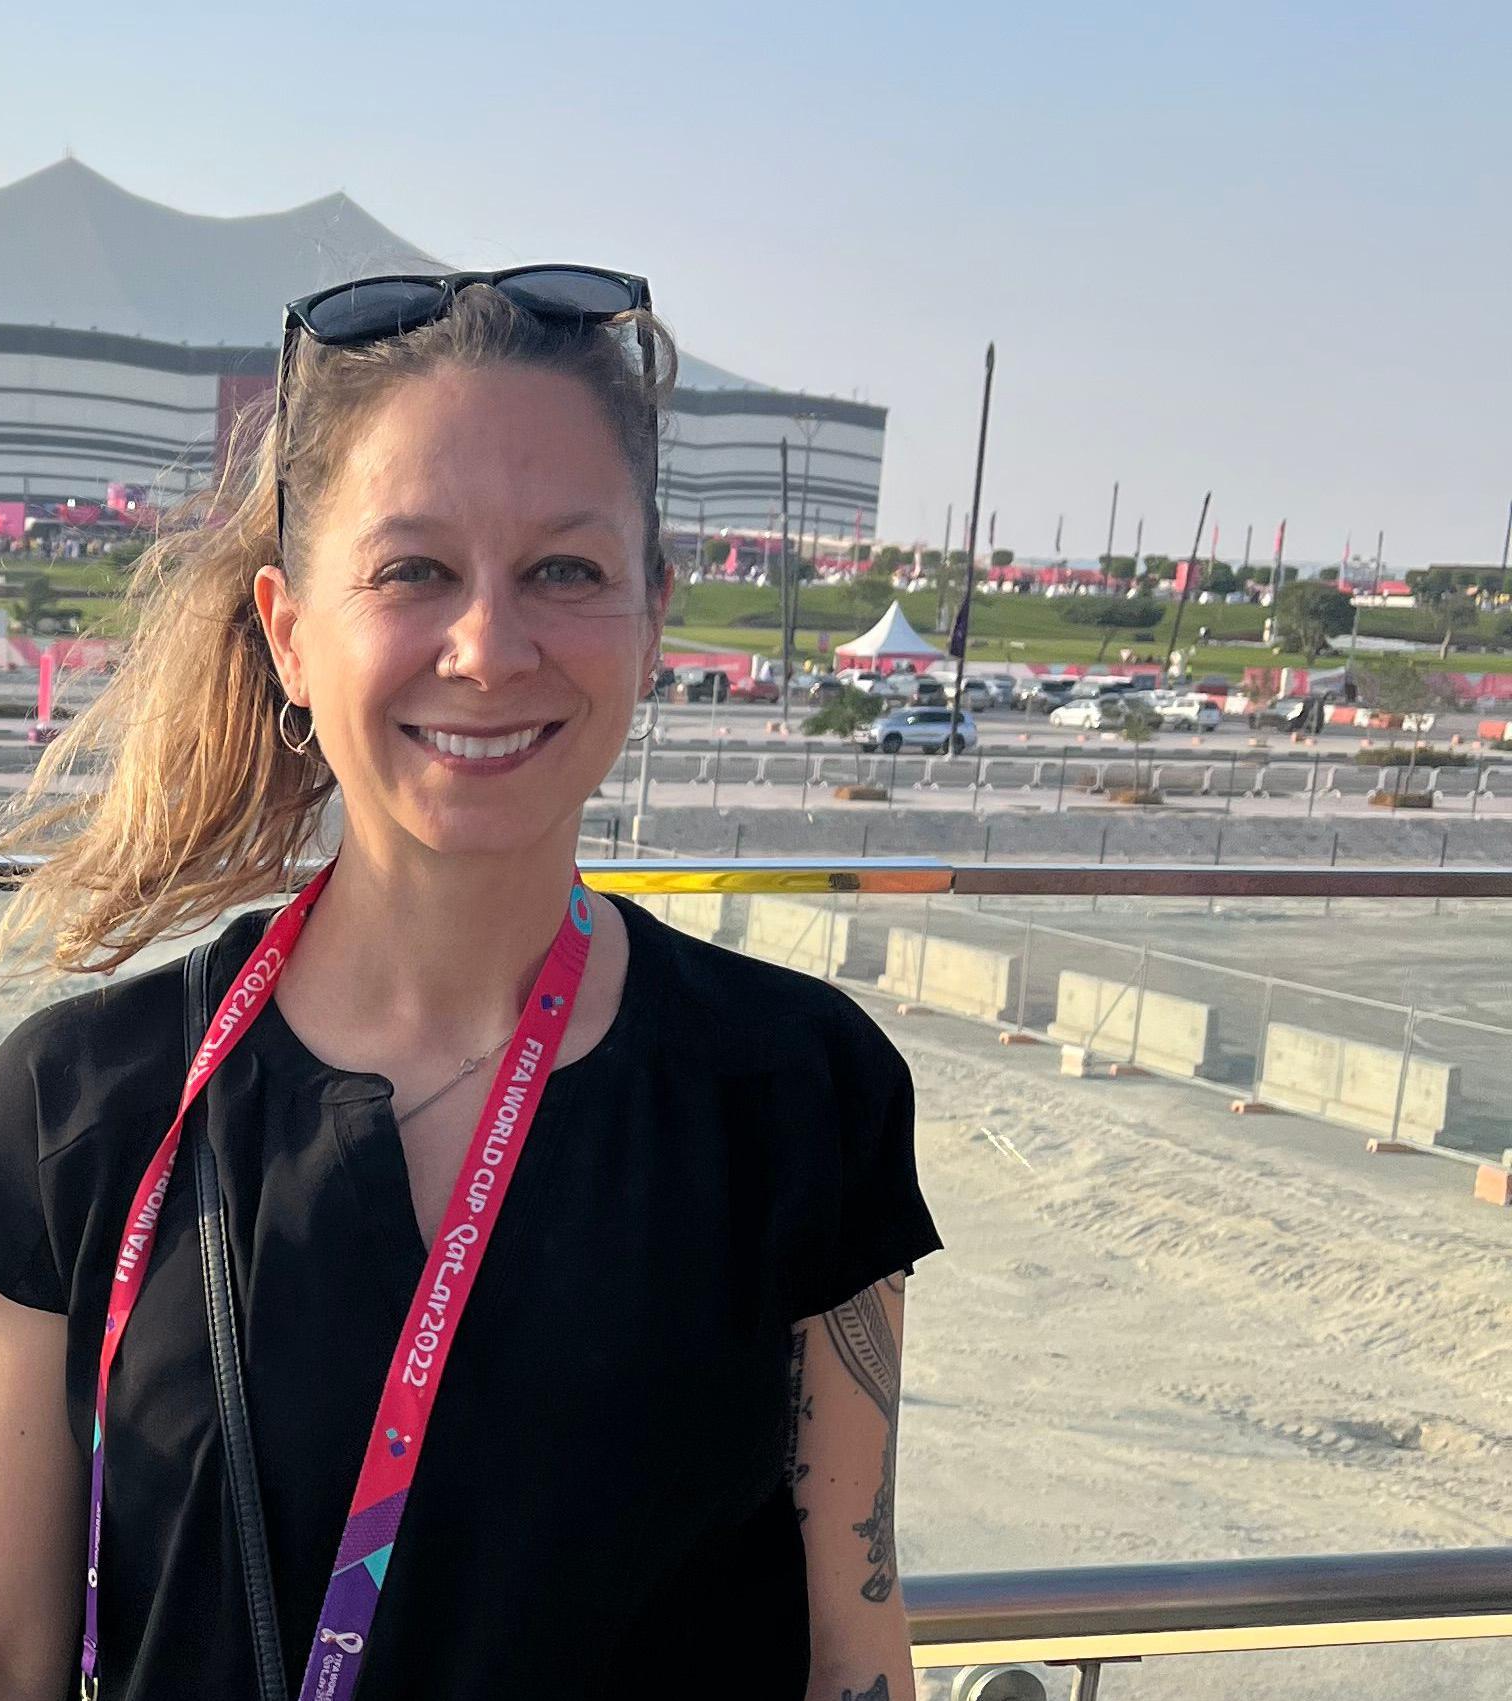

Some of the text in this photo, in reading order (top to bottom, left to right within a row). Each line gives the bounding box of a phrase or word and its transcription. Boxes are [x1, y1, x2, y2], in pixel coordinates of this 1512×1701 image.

[115, 1233, 149, 1283] FIFA
[402, 1037, 544, 1387] FIFA WORLD CUP Qatar2022
